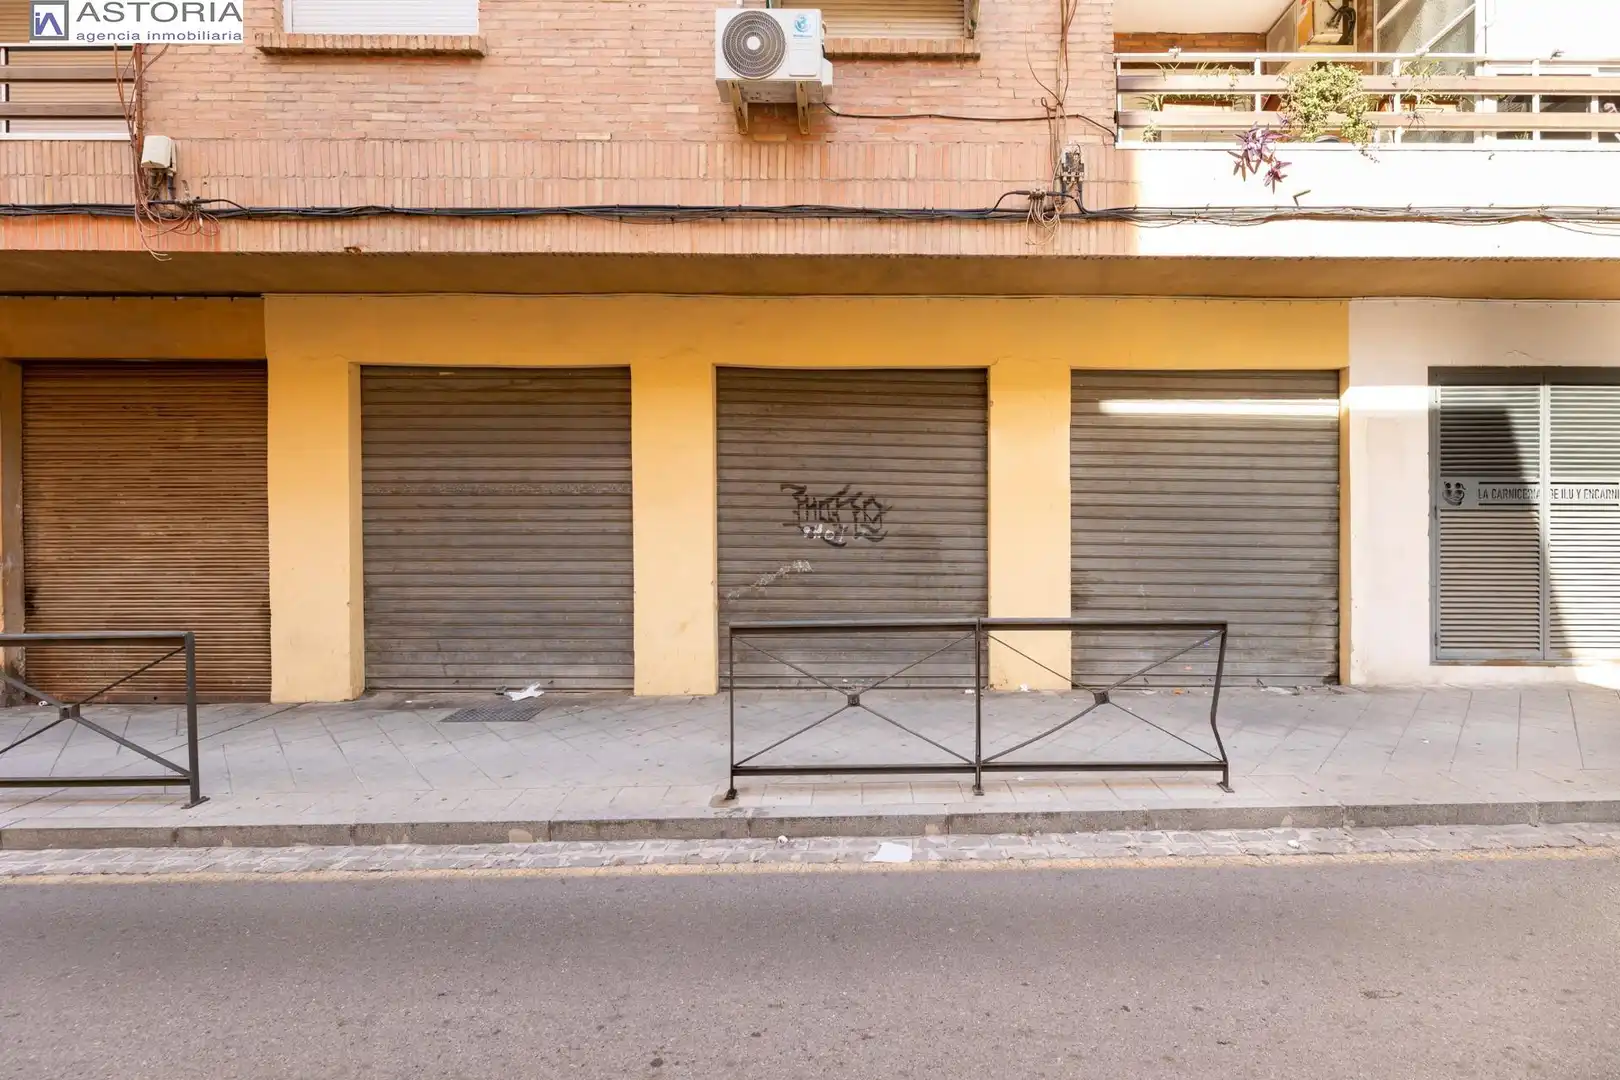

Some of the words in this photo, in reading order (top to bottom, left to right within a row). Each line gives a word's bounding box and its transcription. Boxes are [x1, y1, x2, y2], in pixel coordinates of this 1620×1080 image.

[1478, 488, 1489, 499] LA
[1561, 488, 1574, 499] ILU
[1576, 488, 1582, 499] Y
